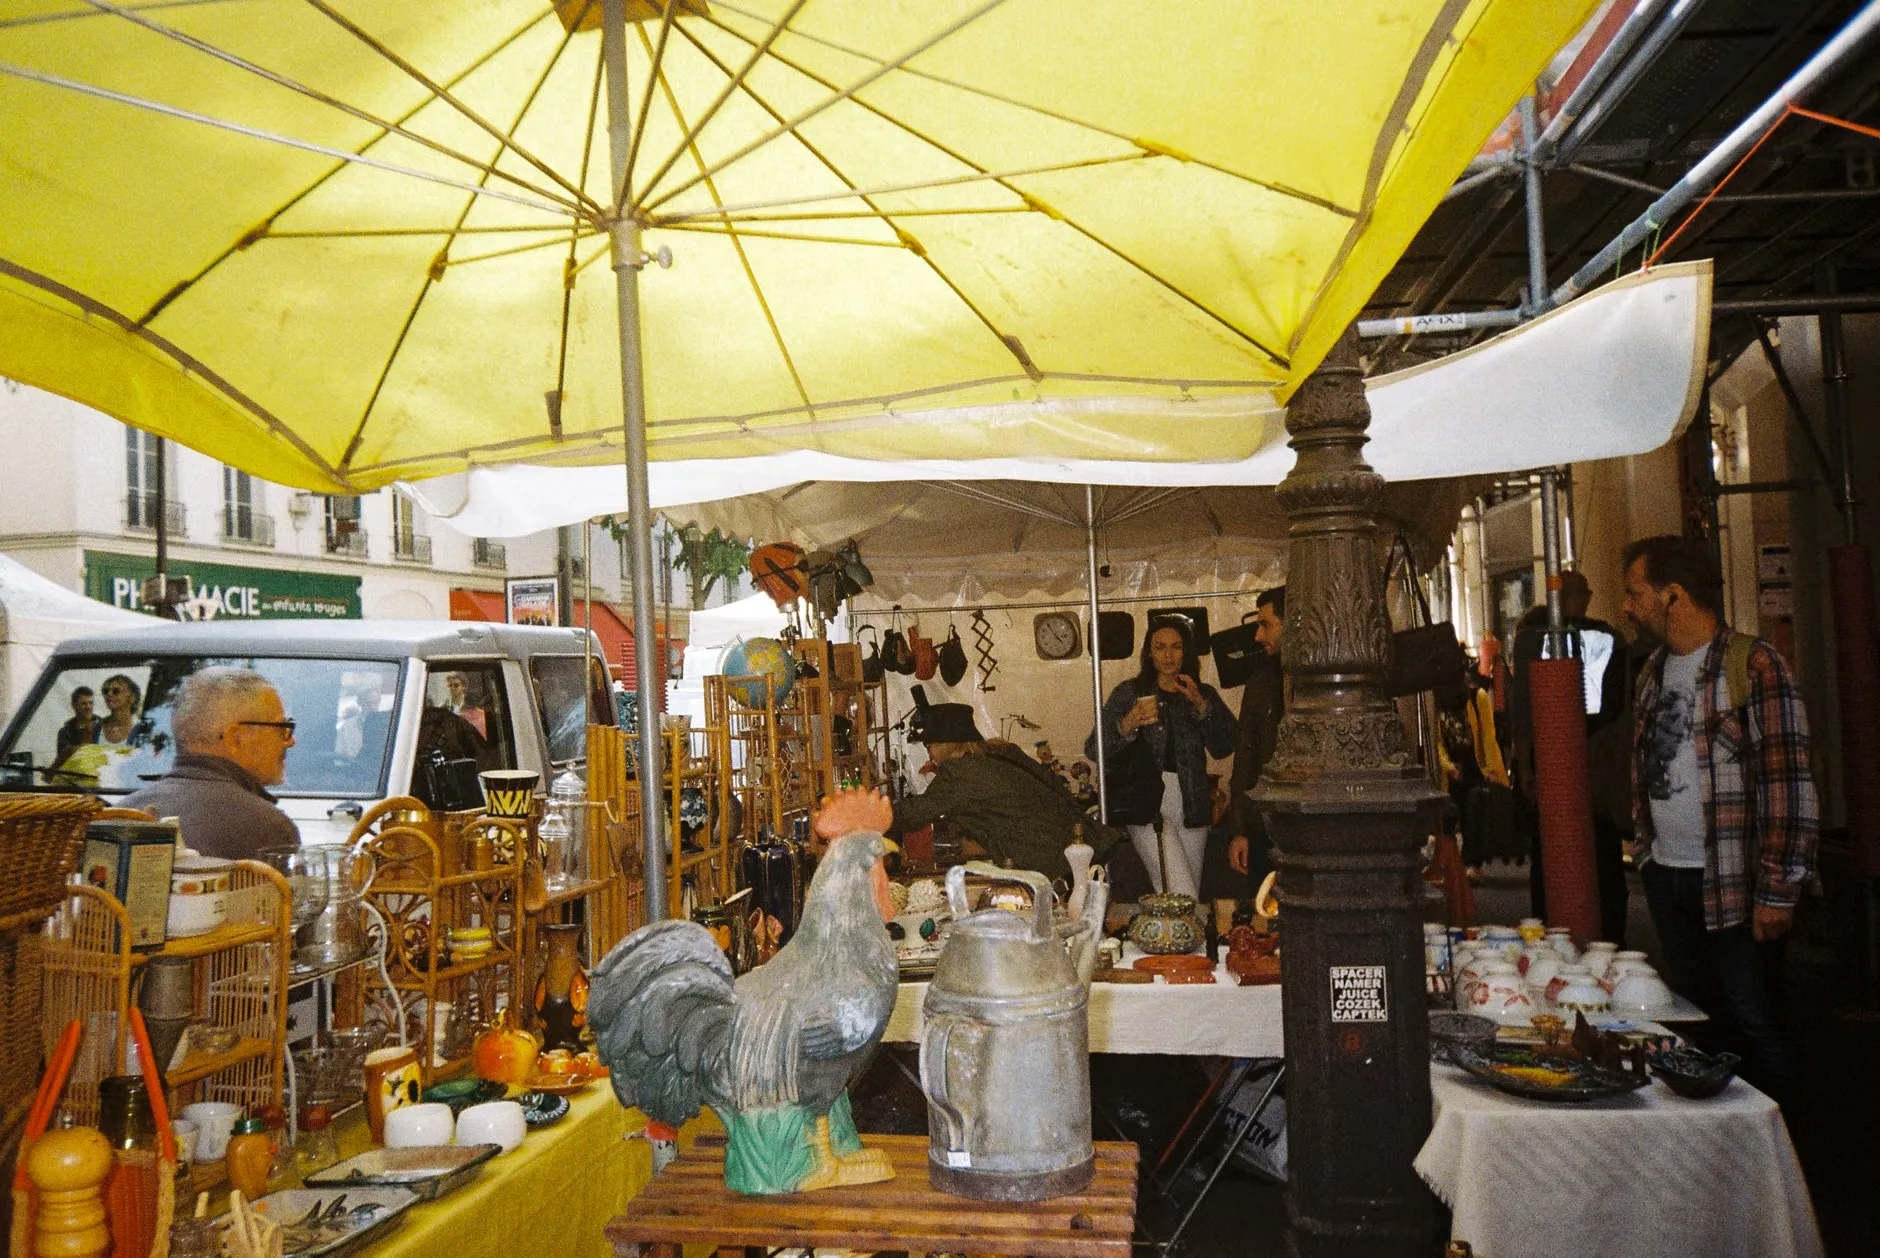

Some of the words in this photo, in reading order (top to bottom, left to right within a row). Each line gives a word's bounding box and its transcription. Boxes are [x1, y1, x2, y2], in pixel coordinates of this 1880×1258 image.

[1334, 979, 1382, 989] NAMER
[1338, 989, 1378, 999] JUICE
[1336, 999, 1381, 1009] COZEK
[1333, 1009, 1386, 1020] CAPTEK
